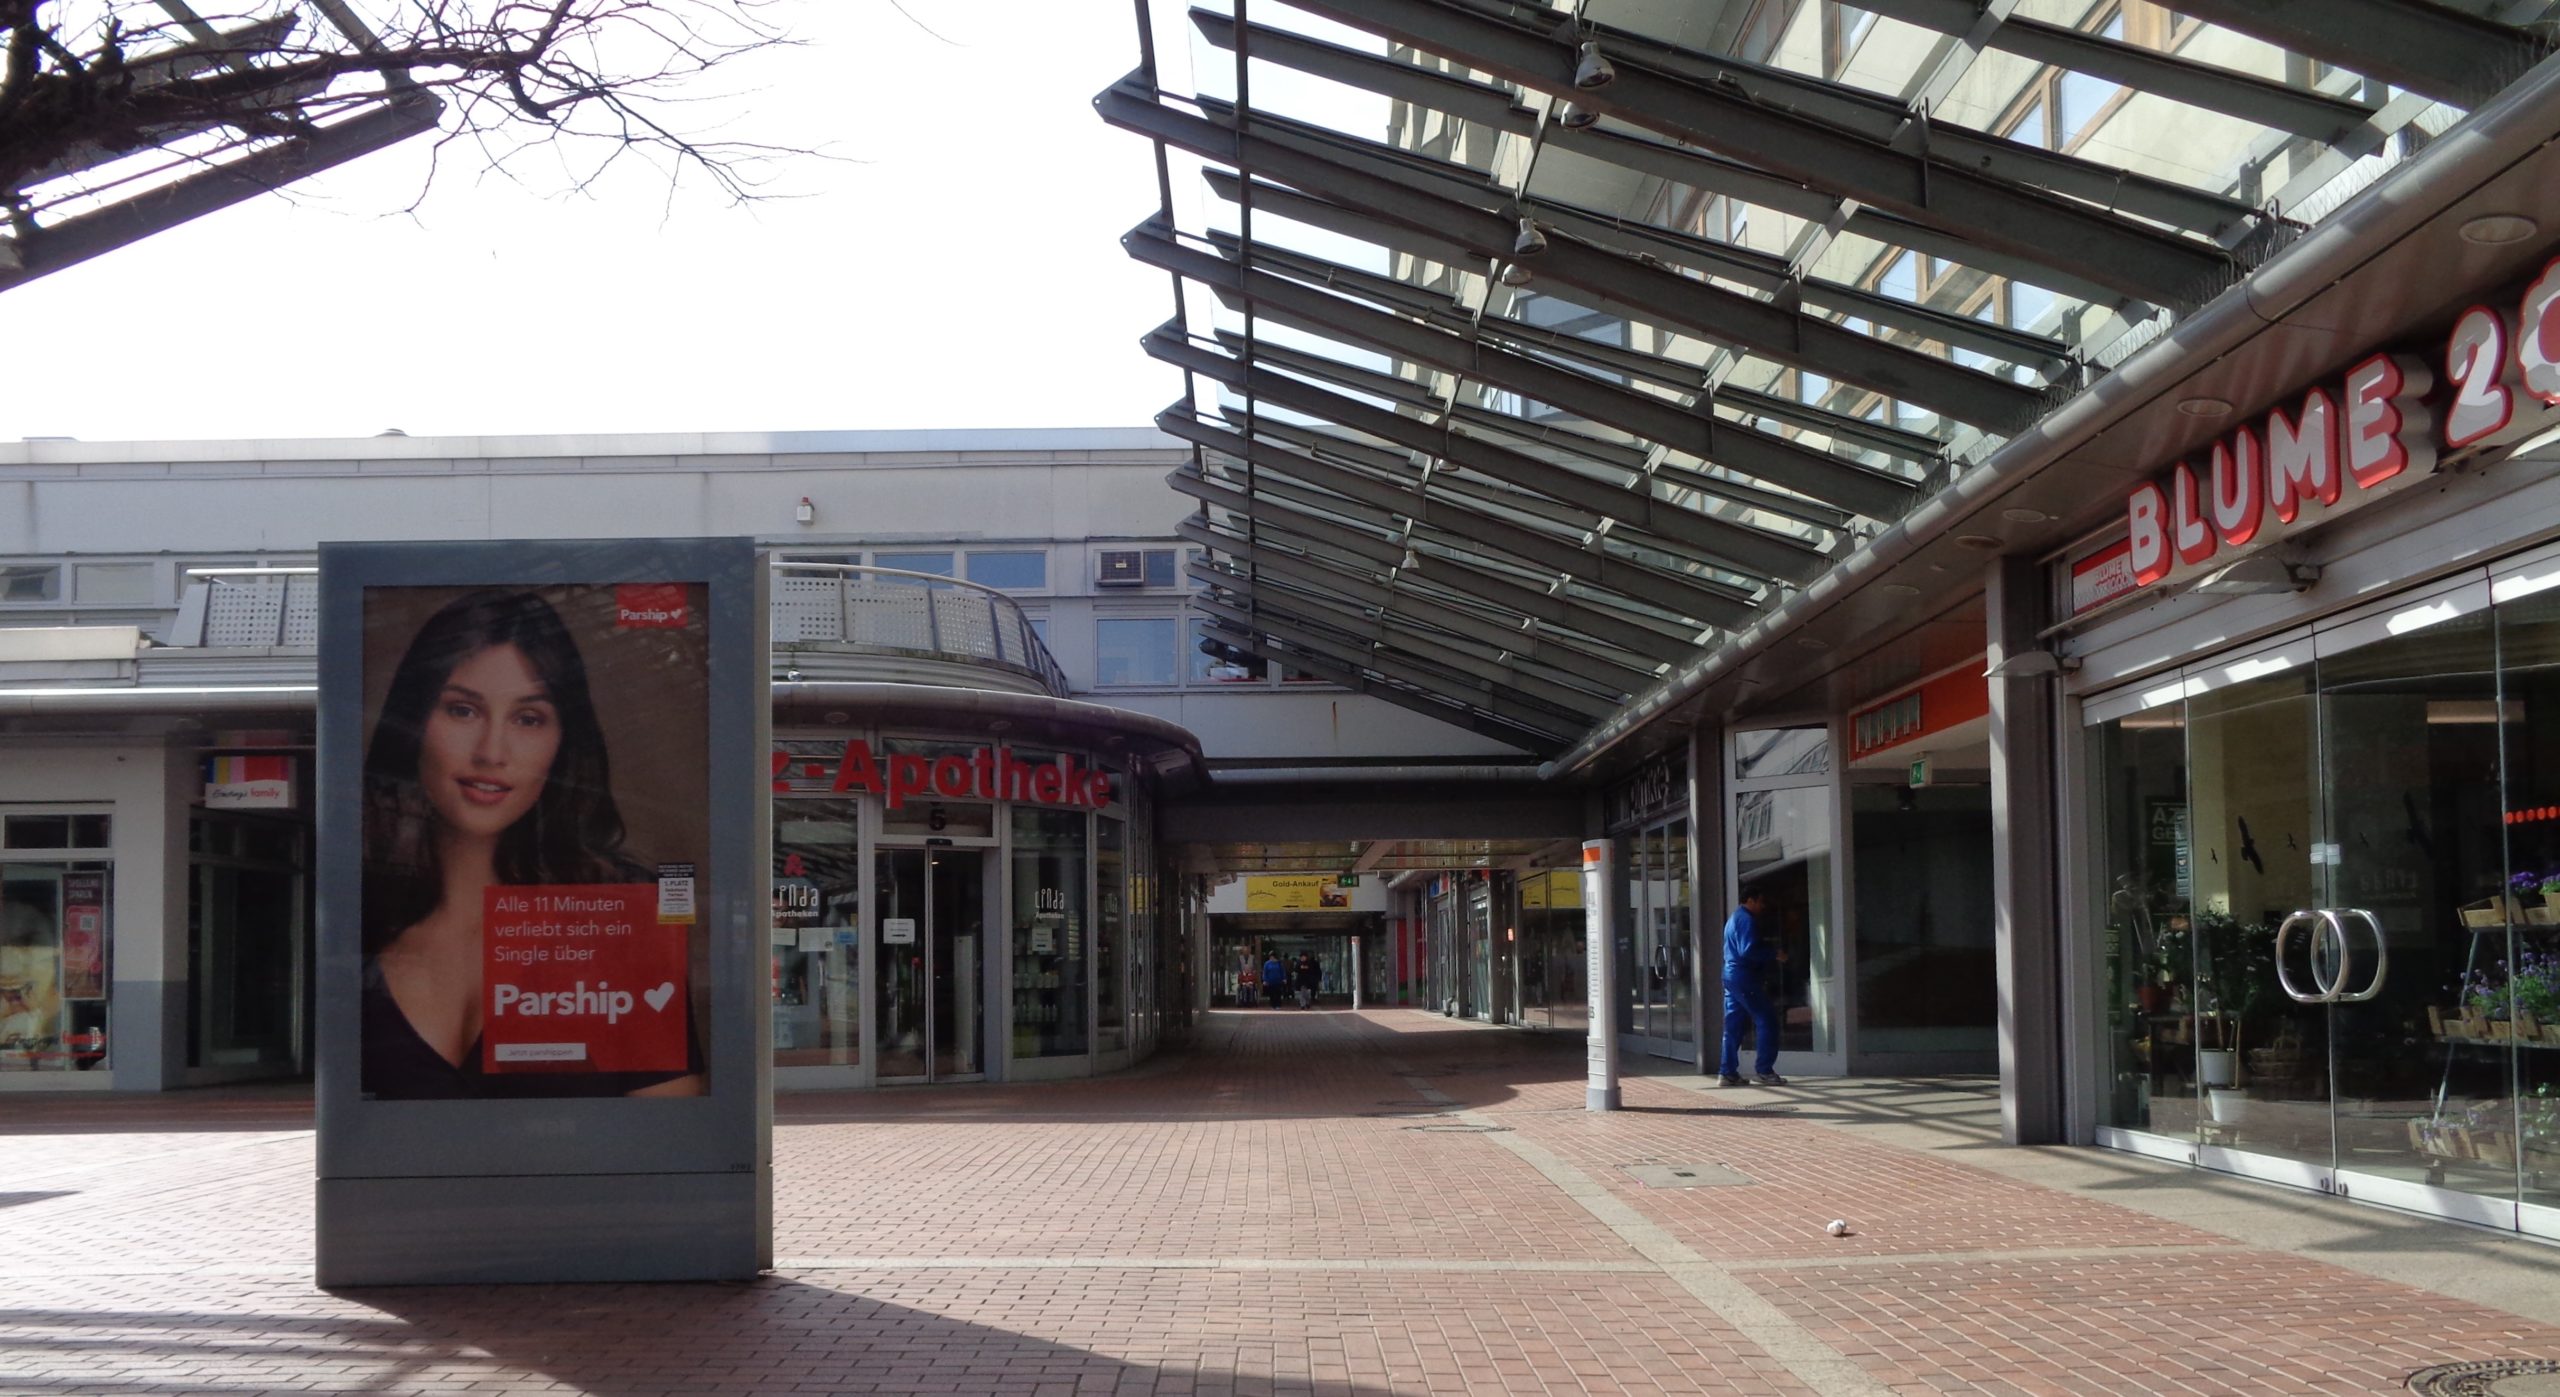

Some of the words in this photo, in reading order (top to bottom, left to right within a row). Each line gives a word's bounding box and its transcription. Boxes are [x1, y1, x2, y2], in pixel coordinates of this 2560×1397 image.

[2129, 352, 2409, 587] BLUME
[621, 608, 668, 623] Parship
[250, 787, 280, 799] family
[1272, 880, 1319, 888] Gold-Ankauf
[494, 897, 528, 913] Alle
[534, 897, 548, 912] 11
[554, 896, 625, 911] Minuten
[495, 921, 561, 937] verliebt
[566, 920, 599, 936] sich
[605, 921, 631, 936] ein
[494, 946, 549, 965] Single
[554, 946, 595, 961] über
[494, 981, 634, 1025] Parship
